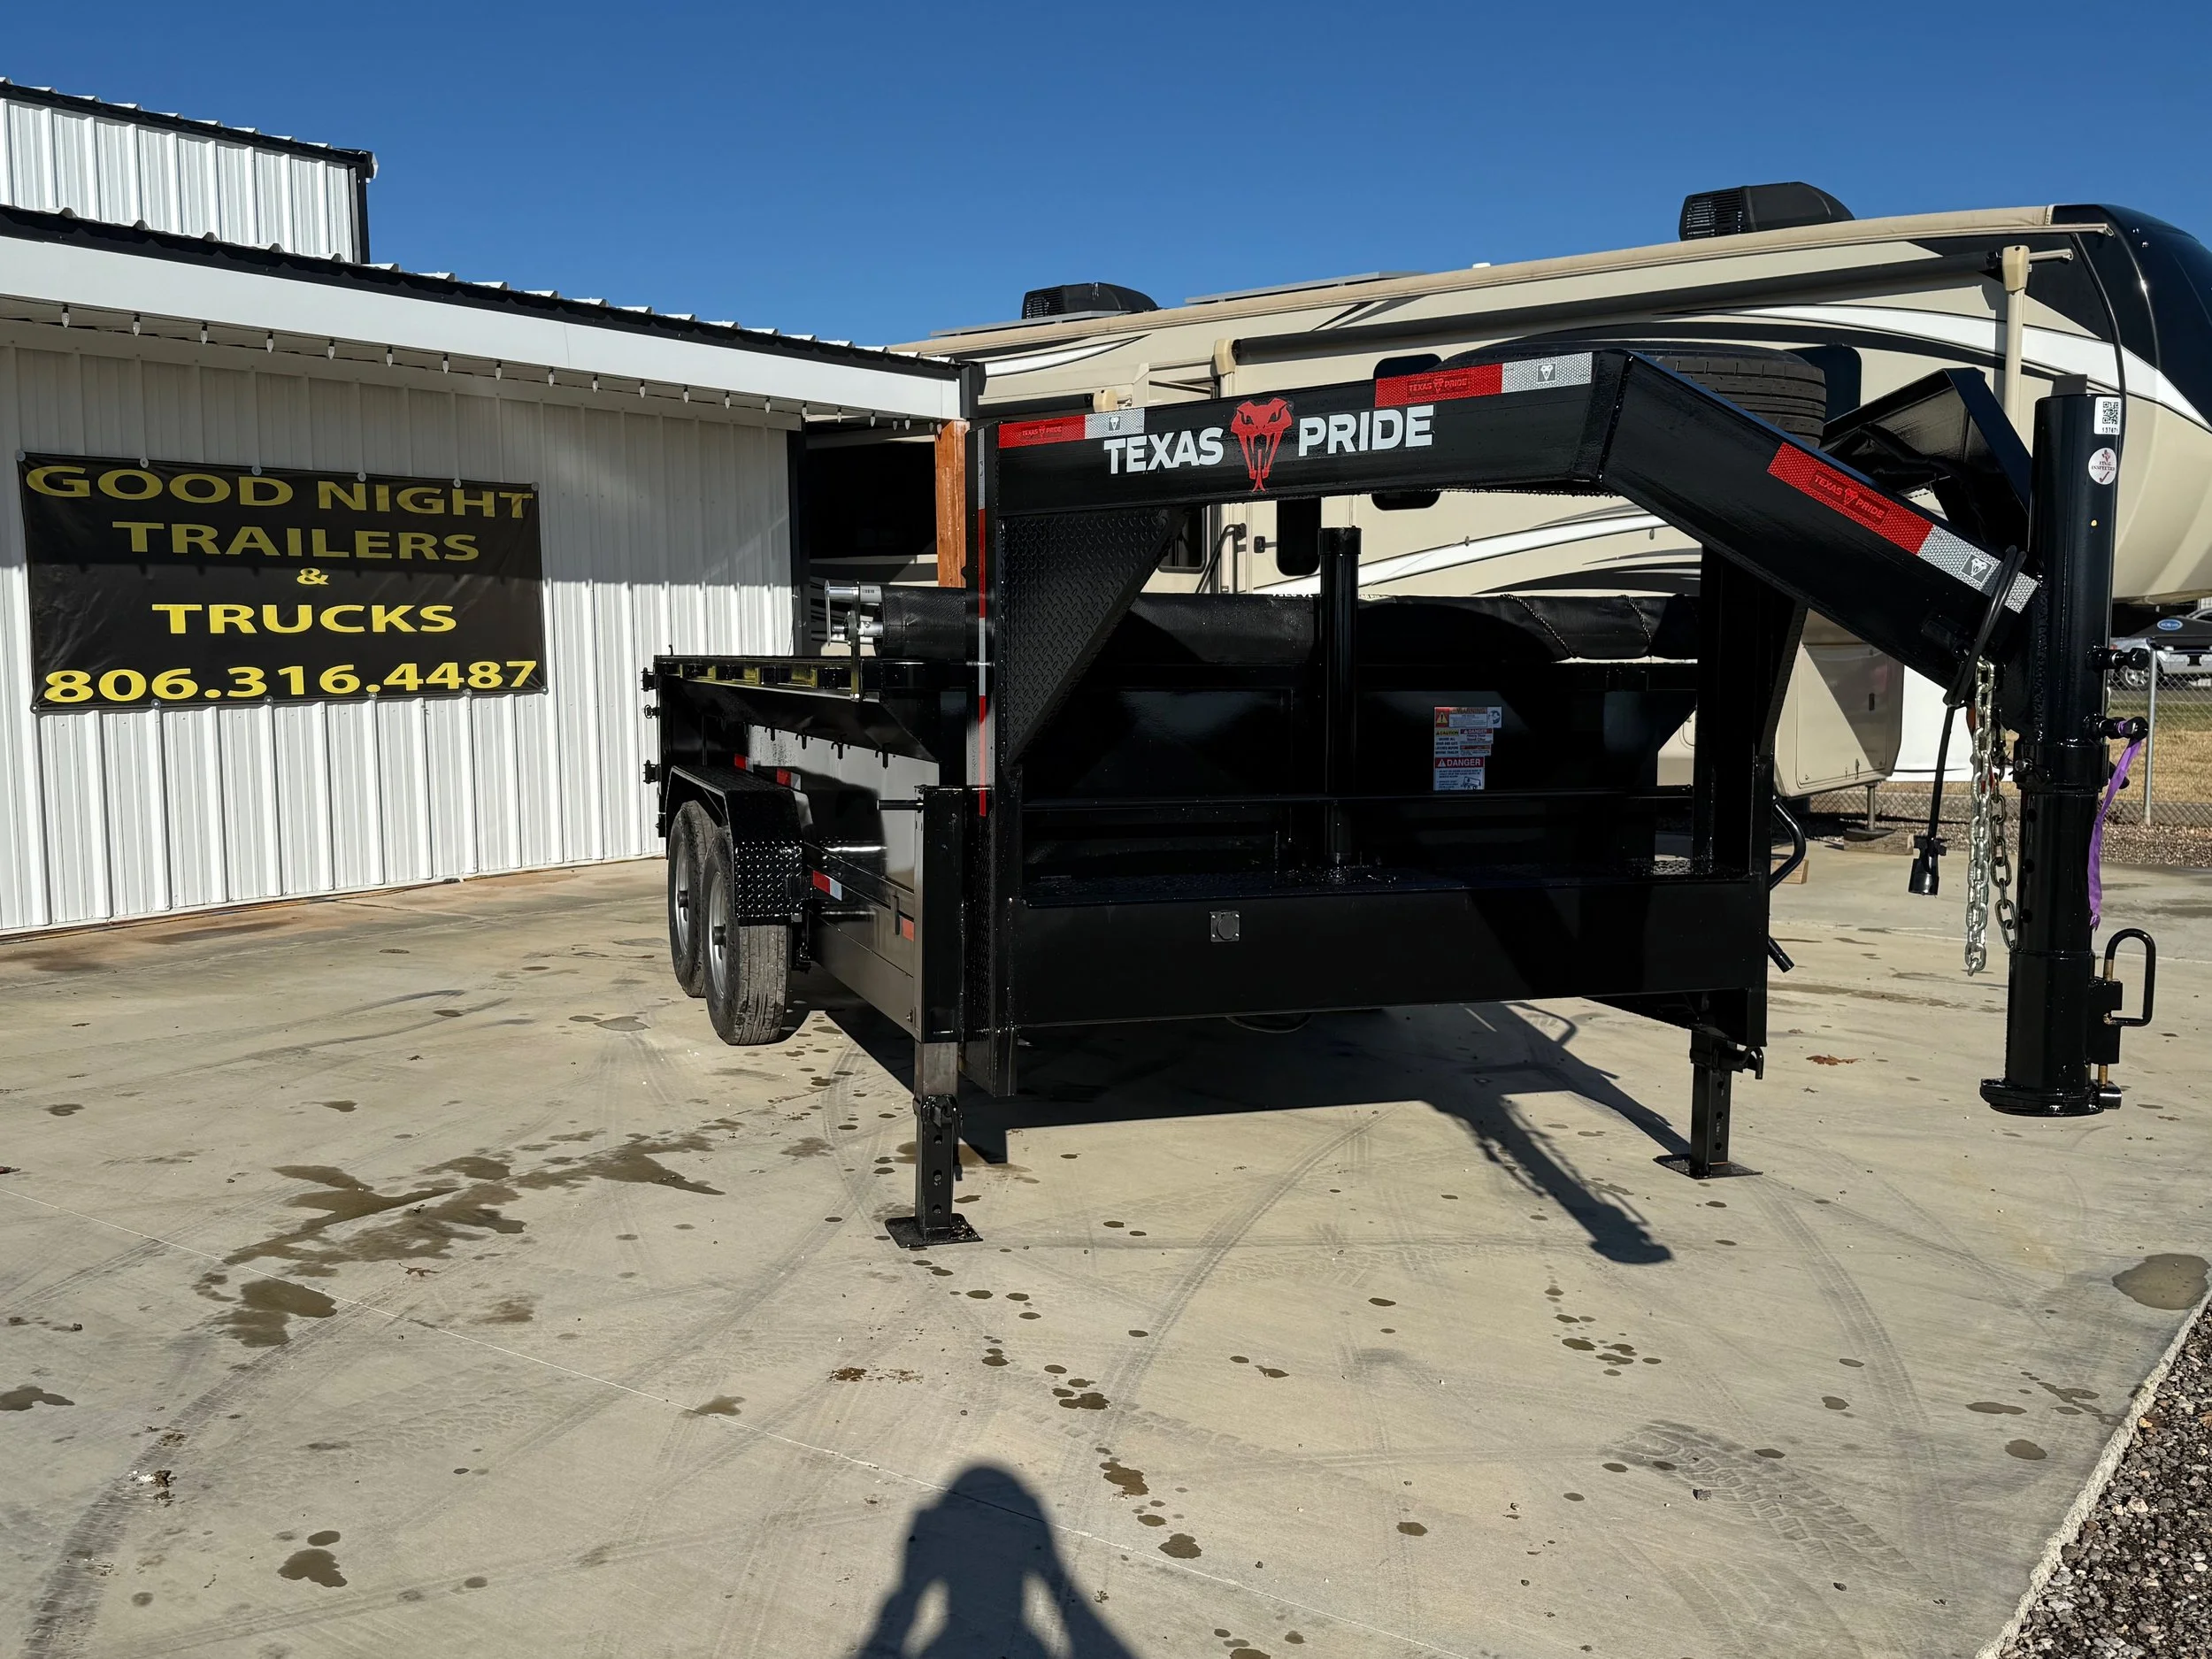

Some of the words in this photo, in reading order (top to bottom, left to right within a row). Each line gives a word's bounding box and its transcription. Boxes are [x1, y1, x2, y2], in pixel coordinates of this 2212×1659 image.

[1409, 383, 1432, 392] TEXAS
[1444, 378, 1467, 388] PRIDE
[1103, 427, 1224, 473] TEXAS
[1298, 404, 1434, 457] PRIDE
[27, 465, 293, 506] GOOD
[319, 481, 534, 519] NIGHT
[1815, 474, 1844, 495] TEXAS
[1855, 497, 1885, 518] PRIDE
[112, 521, 480, 561] TRAILERS
[296, 567, 329, 586] &
[152, 603, 457, 634] TRUCKS
[44, 660, 537, 703] 806.316.4487
